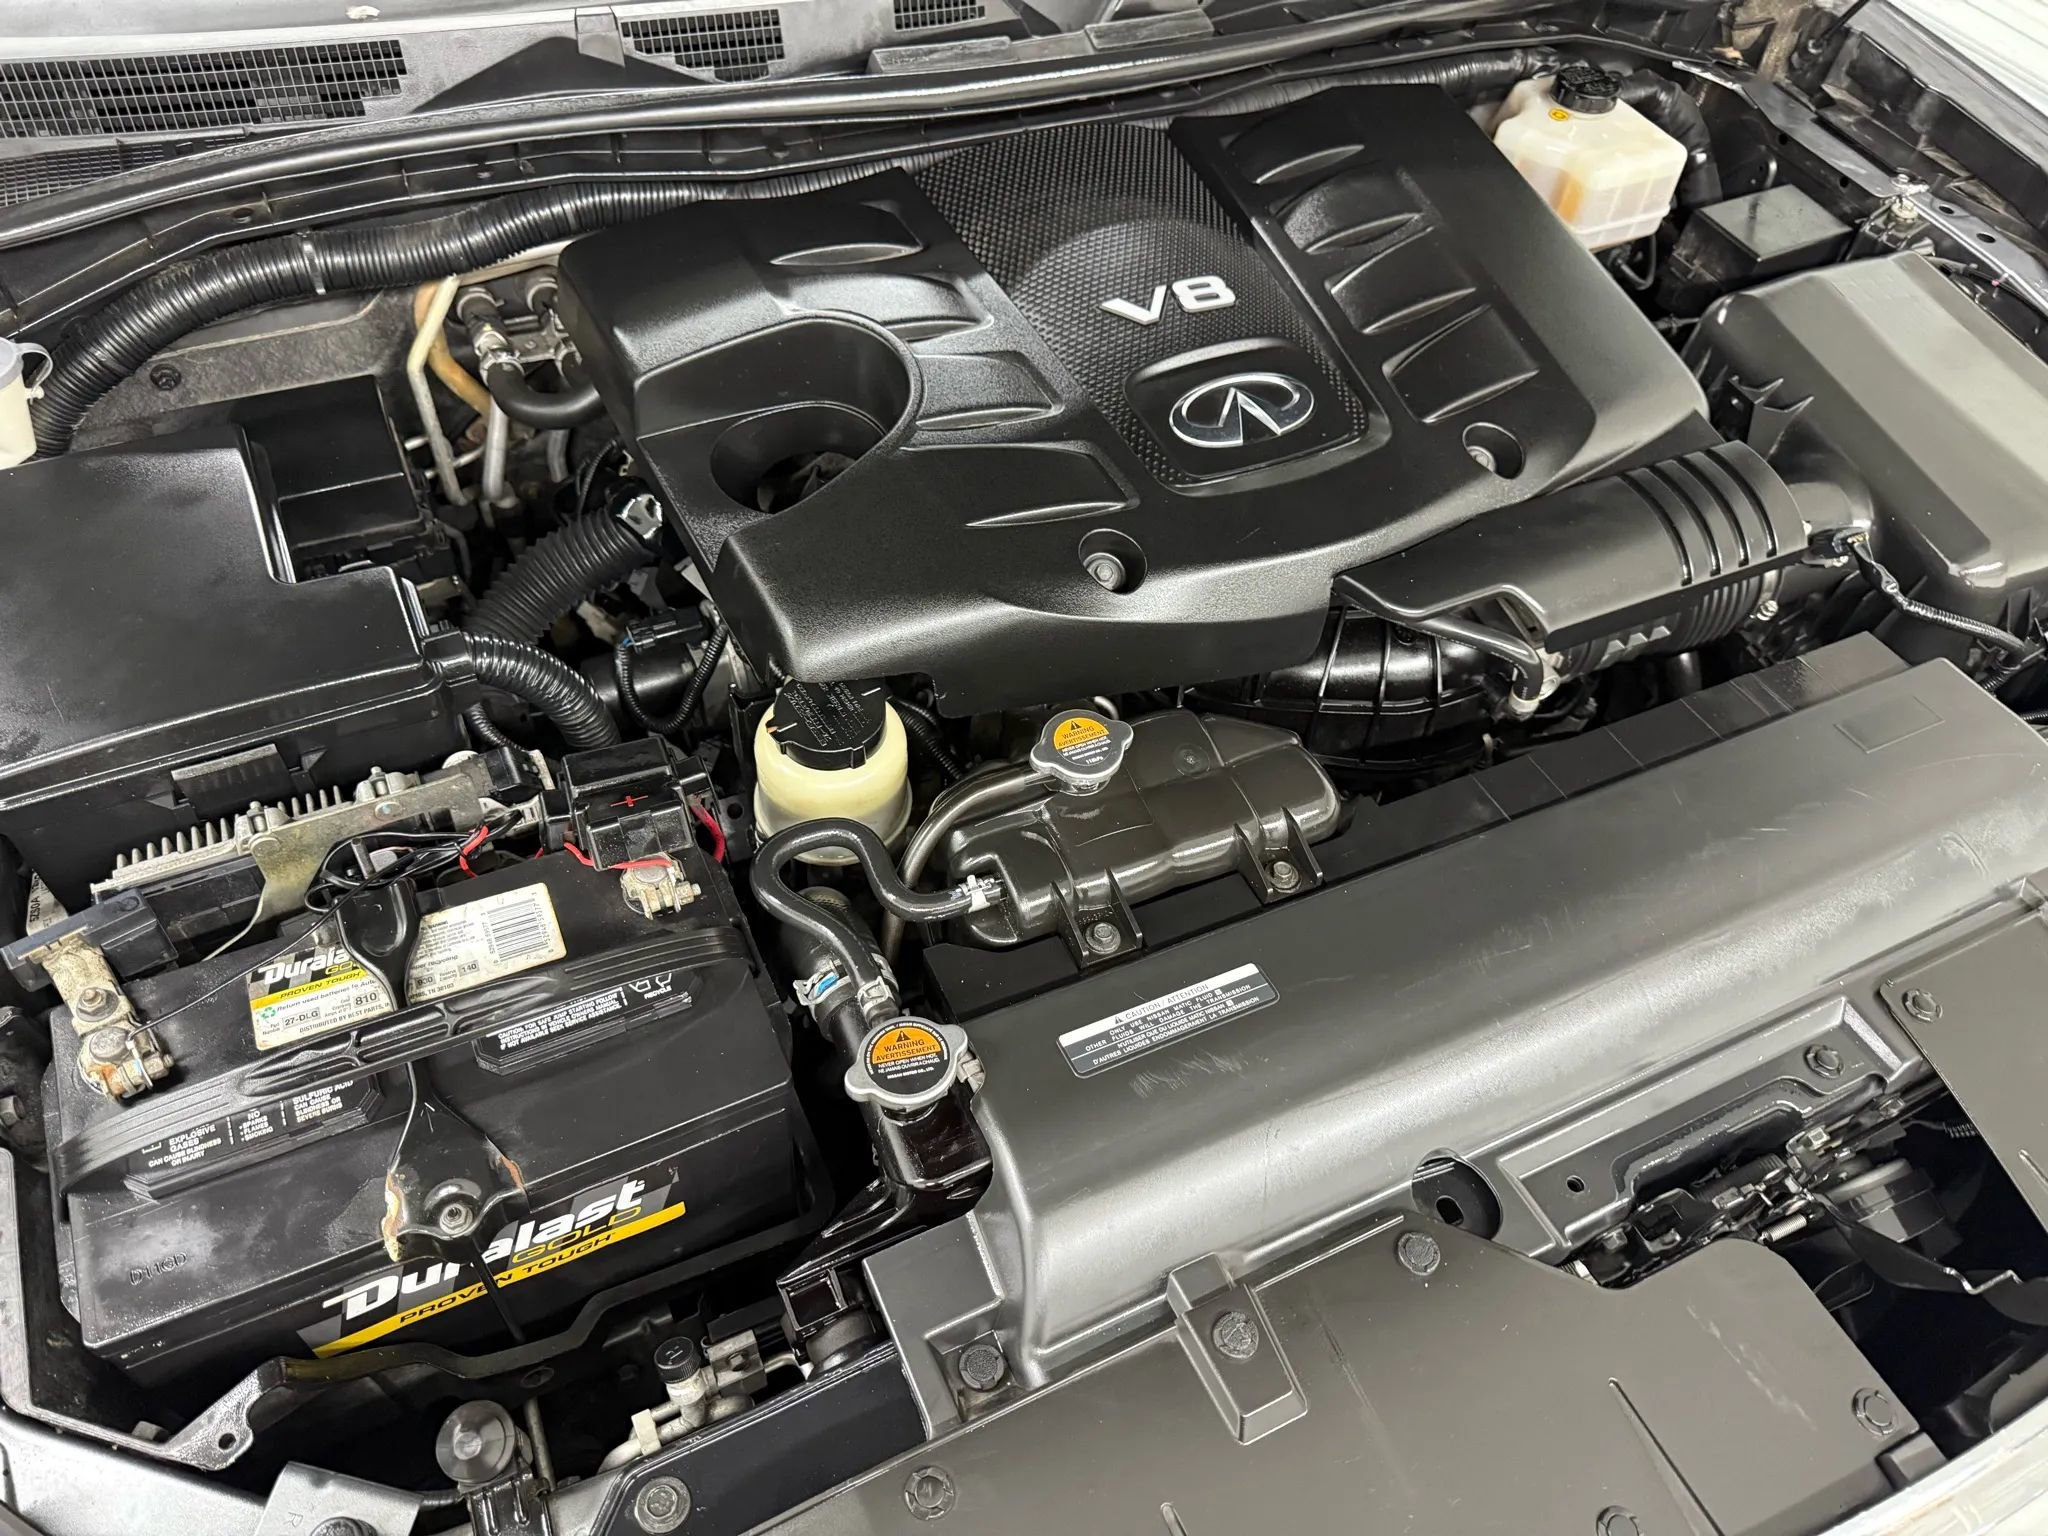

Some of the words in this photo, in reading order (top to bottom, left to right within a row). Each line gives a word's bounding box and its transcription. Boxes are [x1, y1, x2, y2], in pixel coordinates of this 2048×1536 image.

[1101, 275, 1235, 326] V8
[1058, 729, 1105, 747] AVERTISSEMENT
[1061, 726, 1094, 740] WARNING
[258, 947, 349, 984] Durala
[325, 961, 356, 975] GO
[461, 963, 477, 973] 140
[280, 983, 322, 999] PROVEN
[326, 972, 361, 987] TOUGH
[436, 983, 454, 992] 38103
[644, 985, 672, 999] RECYCLE
[276, 1000, 301, 1011] Return
[302, 995, 319, 1004] used
[320, 987, 349, 1001] batteries
[355, 992, 377, 1006] 810
[537, 1016, 551, 1025] SAFE
[552, 1011, 567, 1020] JUMP
[567, 1000, 595, 1014] STARTING
[595, 993, 617, 1004] FOLLOW
[1124, 1001, 1161, 1020] CAUTION
[1166, 982, 1209, 1004] ATTENTION
[284, 1011, 319, 1026] 27-DLG
[299, 1017, 338, 1033] DISTRIBUTED
[339, 1015, 347, 1023] BY
[348, 1010, 362, 1019] BEST
[363, 1004, 384, 1015] PARTS,
[1085, 1038, 1106, 1051] OTHER
[1111, 1028, 1134, 1041] FLUIDS
[1138, 1020, 1154, 1030] WILL
[1159, 1009, 1184, 1023] DAMAGE
[1189, 1002, 1201, 1011] THE
[1206, 983, 1251, 1005] TRANSMISSION
[1109, 1025, 1125, 1036] ONLY
[1129, 1019, 1142, 1028] USE
[1146, 1009, 1169, 1021] NISSAN
[1173, 1000, 1192, 1011] MATIC
[1195, 992, 1213, 1002] FLUID
[500, 1026, 540, 1044] INSTRUCTIONS
[547, 1015, 570, 1027] VEHICLE
[506, 1039, 519, 1047] NOT
[519, 1029, 549, 1043] AVAILABLE
[549, 1023, 564, 1032] SEEK
[564, 1015, 587, 1027] SERVICE
[1092, 1049, 1121, 1065] D'AUTRES
[1123, 1038, 1150, 1053] LIQUIDES
[1151, 1015, 1207, 1041] ENDOMMAGERAIENT
[1218, 995, 1259, 1016] TRANSMISSION
[1117, 1033, 1146, 1048] N'UTILISER
[1145, 1028, 1158, 1037] QUE
[1167, 1017, 1188, 1029] LIQUIDE
[1188, 1010, 1205, 1021] MATIC
[1204, 1003, 1225, 1014] NISSAN
[876, 1045, 936, 1061] AVERTISSEMENT
[884, 1039, 925, 1052] WARNING
[291, 1085, 333, 1104] SULFURIC
[334, 1080, 354, 1092] ACID
[293, 1101, 308, 1110] CAN
[309, 1093, 331, 1105] CAUSE
[248, 1111, 261, 1120] NO
[294, 1100, 329, 1116] BLINDNESS
[330, 1096, 340, 1104] OR
[296, 1109, 321, 1122] SEVERE
[321, 1102, 342, 1113] BURNS
[243, 1115, 268, 1128] SPARKS
[244, 1122, 269, 1134] FLAMES
[168, 1124, 216, 1145] EXPLOSIVE
[169, 1137, 200, 1152] GASES
[245, 1127, 273, 1142] SMOKING
[147, 1157, 163, 1167] CAN
[162, 1149, 186, 1162] CAUSE
[185, 1137, 221, 1154] BLINDNESS
[170, 1158, 181, 1166] OR
[181, 1150, 205, 1162] INJURY
[512, 1207, 641, 1264] GOLD
[400, 1272, 514, 1324] PROVEN
[523, 1234, 613, 1276] TOUGH
